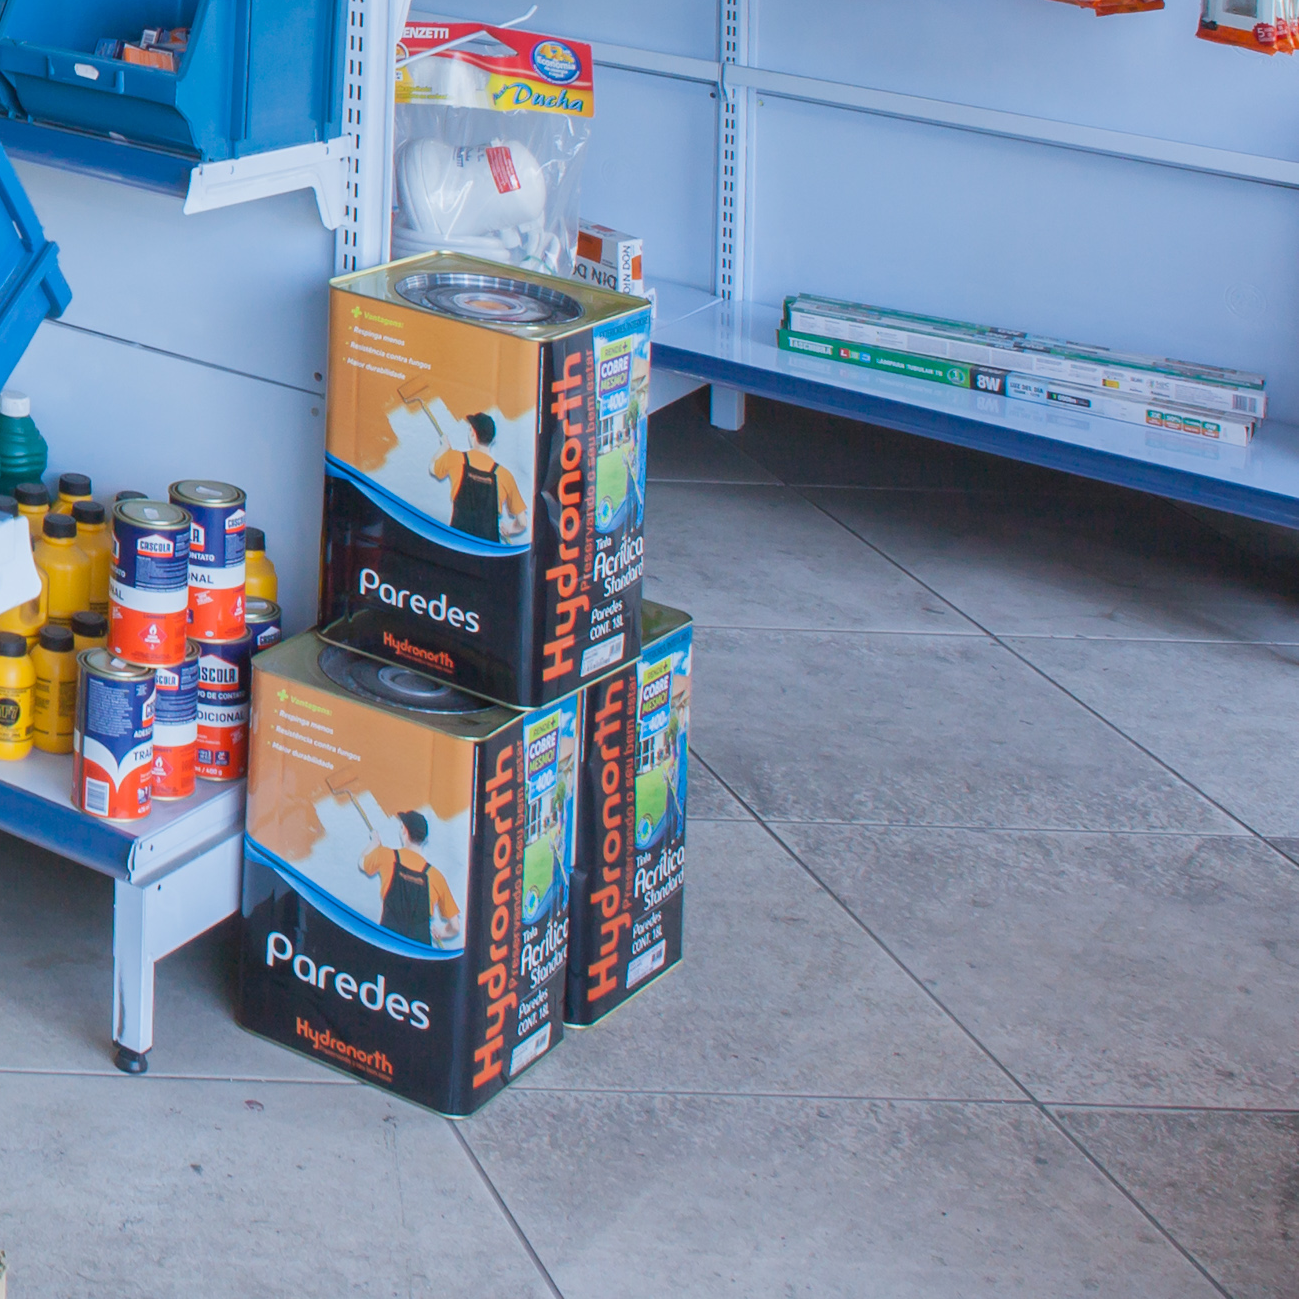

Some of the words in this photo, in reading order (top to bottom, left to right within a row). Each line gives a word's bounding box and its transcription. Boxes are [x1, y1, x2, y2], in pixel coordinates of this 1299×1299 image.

[402, 26, 449, 40] ENZETTI
[536, 55, 577, 72] Economia
[508, 81, 584, 112] Ducha
[383, 335, 405, 347] menos
[386, 351, 408, 363] contra
[408, 356, 432, 371] fungos
[585, 349, 595, 392] estar
[601, 355, 629, 378] COBRE
[975, 373, 1001, 392] 8W
[586, 395, 596, 434] bem
[543, 351, 590, 682] Hydronorth
[140, 540, 172, 553] CASCOLA
[580, 484, 596, 592] Preservando
[595, 535, 612, 552] Tinta
[593, 533, 644, 583] Acrílica
[359, 568, 481, 634] Paredes
[590, 599, 623, 625] Paredes
[589, 620, 612, 641] CONT.
[612, 612, 624, 630] 18L
[382, 631, 455, 668] Hydronorth
[206, 691, 217, 700] DE
[626, 676, 637, 716] estar
[643, 674, 670, 701] COBRE
[529, 731, 557, 759] COBRE
[587, 680, 632, 1001] Hydronorth
[633, 845, 685, 899] Acrílica
[635, 853, 652, 869] Tinta
[643, 866, 684, 912] Standard
[473, 745, 518, 1089] Hydronorth
[632, 910, 662, 940] Paredes
[522, 925, 538, 945] Tinta
[631, 932, 652, 956] CONT.
[652, 924, 663, 942] 18L
[266, 931, 431, 1030] Paredes
[517, 987, 549, 1020] Paredes
[517, 1013, 538, 1037] CONT.
[539, 1005, 550, 1023] 18L
[295, 1016, 395, 1076] Hydronorth
